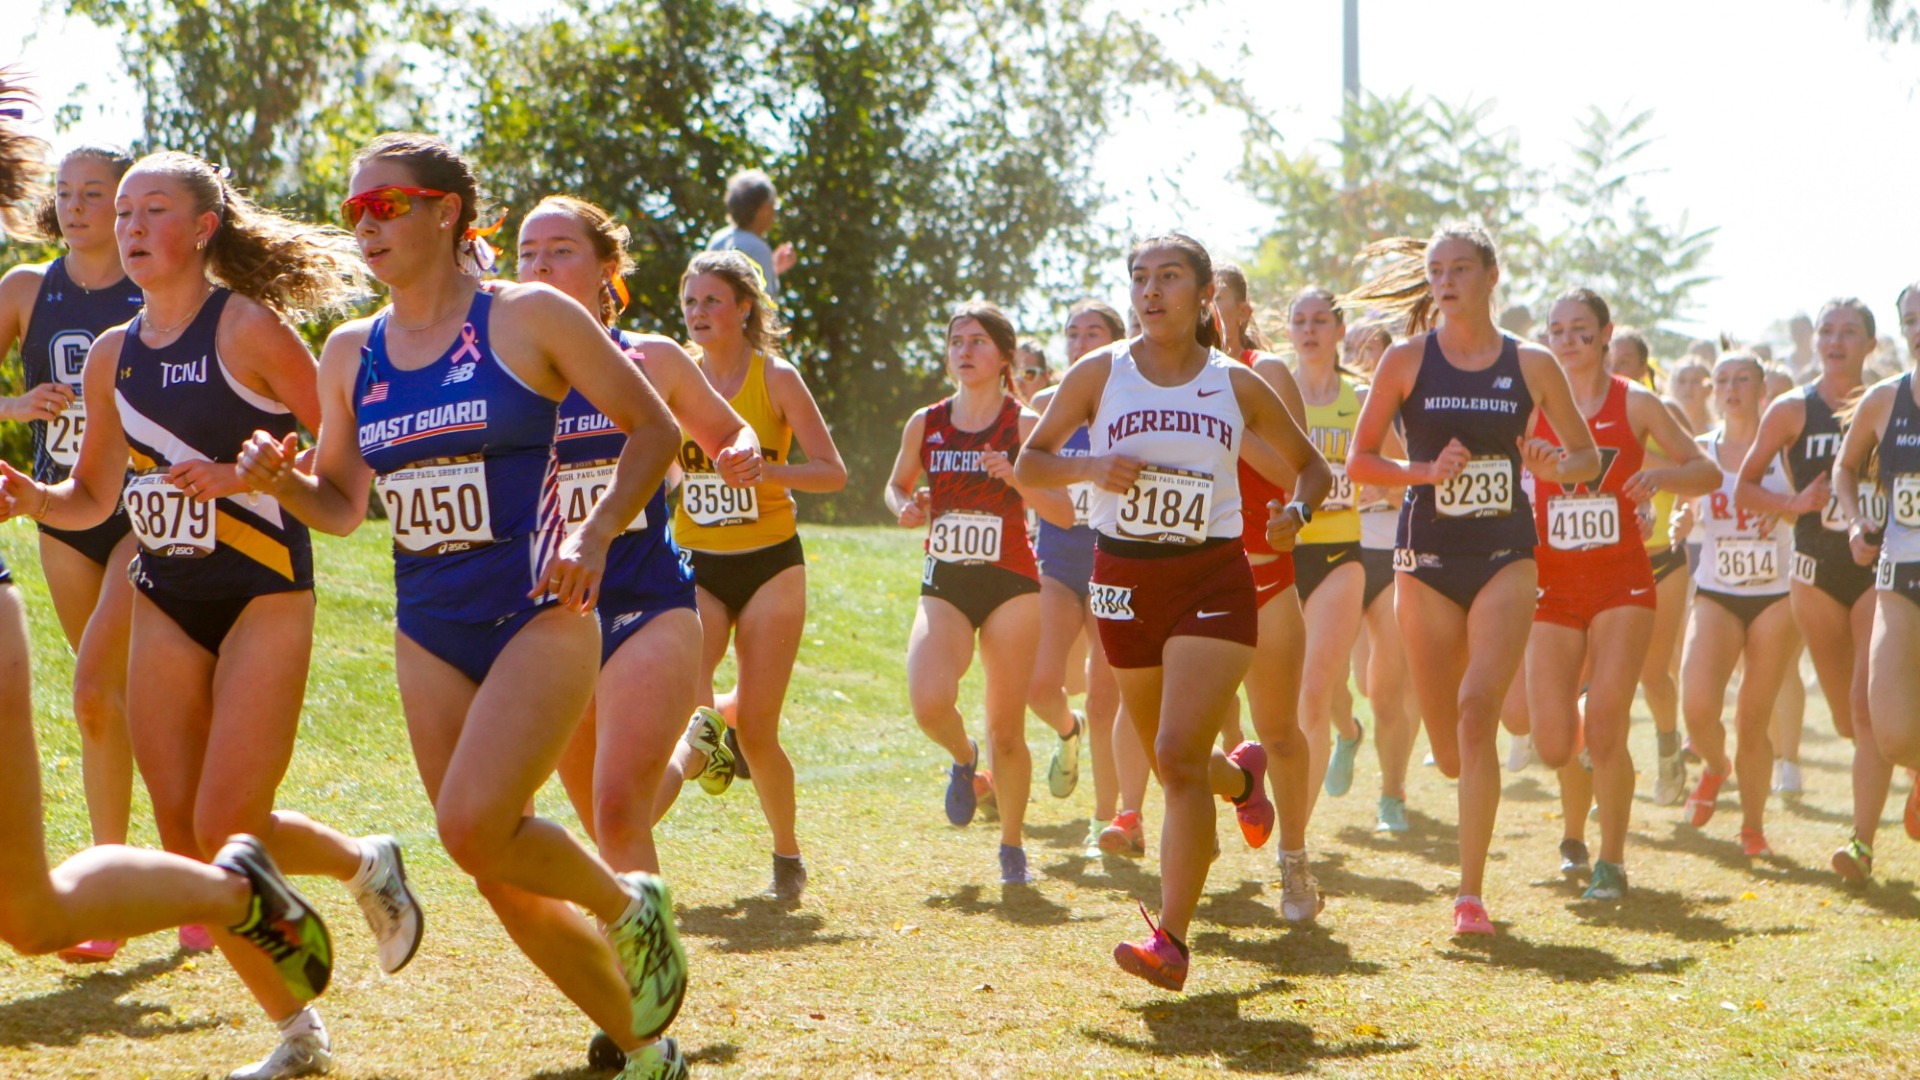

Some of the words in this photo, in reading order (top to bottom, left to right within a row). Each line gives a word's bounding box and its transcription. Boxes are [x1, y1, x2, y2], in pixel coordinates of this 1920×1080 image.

[160, 355, 207, 388] TCNJ
[1424, 397, 1518, 414] MIDDLEBURY
[359, 414, 414, 448] COAST
[415, 400, 487, 432] GUARD
[1108, 410, 1233, 452] MEREDITH
[1896, 434, 1920, 447] MO
[417, 470, 436, 479] PAUL
[438, 468, 461, 477] SHORT
[464, 466, 479, 475] RUN
[929, 450, 1009, 473] LYNCHB
[687, 484, 753, 514] 3590
[1440, 472, 1508, 506] 3233
[128, 490, 209, 539] 3879
[386, 483, 483, 536] 2450
[1121, 485, 1205, 532] 3184
[1551, 510, 1614, 540] 4160
[934, 523, 997, 556] 3100
[1719, 550, 1774, 577] 3614
